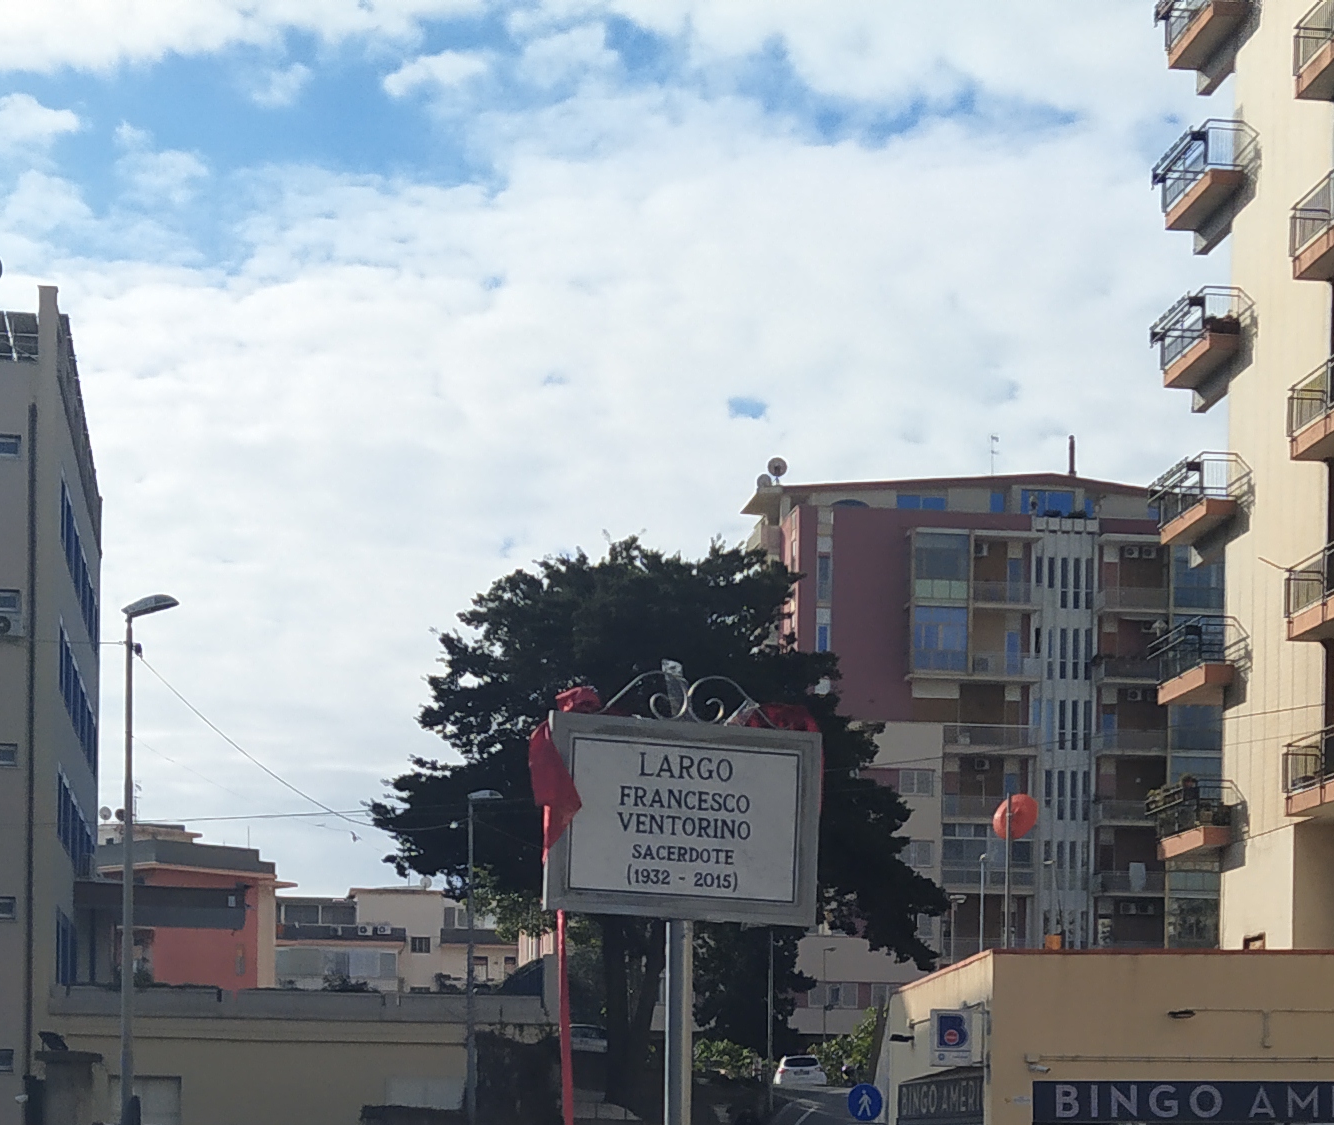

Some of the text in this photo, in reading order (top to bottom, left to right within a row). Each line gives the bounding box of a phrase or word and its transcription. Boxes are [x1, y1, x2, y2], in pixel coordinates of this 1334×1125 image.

[638, 751, 734, 782] LARGO
[619, 785, 750, 814] FRANCESCO
[617, 812, 751, 840] VENTORINO
[632, 843, 735, 866] SACERDOTE
[626, 863, 671, 886] (1932
[694, 871, 739, 893] 2015)
[901, 1080, 983, 1116] BINGO AMERI
[1055, 1083, 1224, 1119] BINGO
